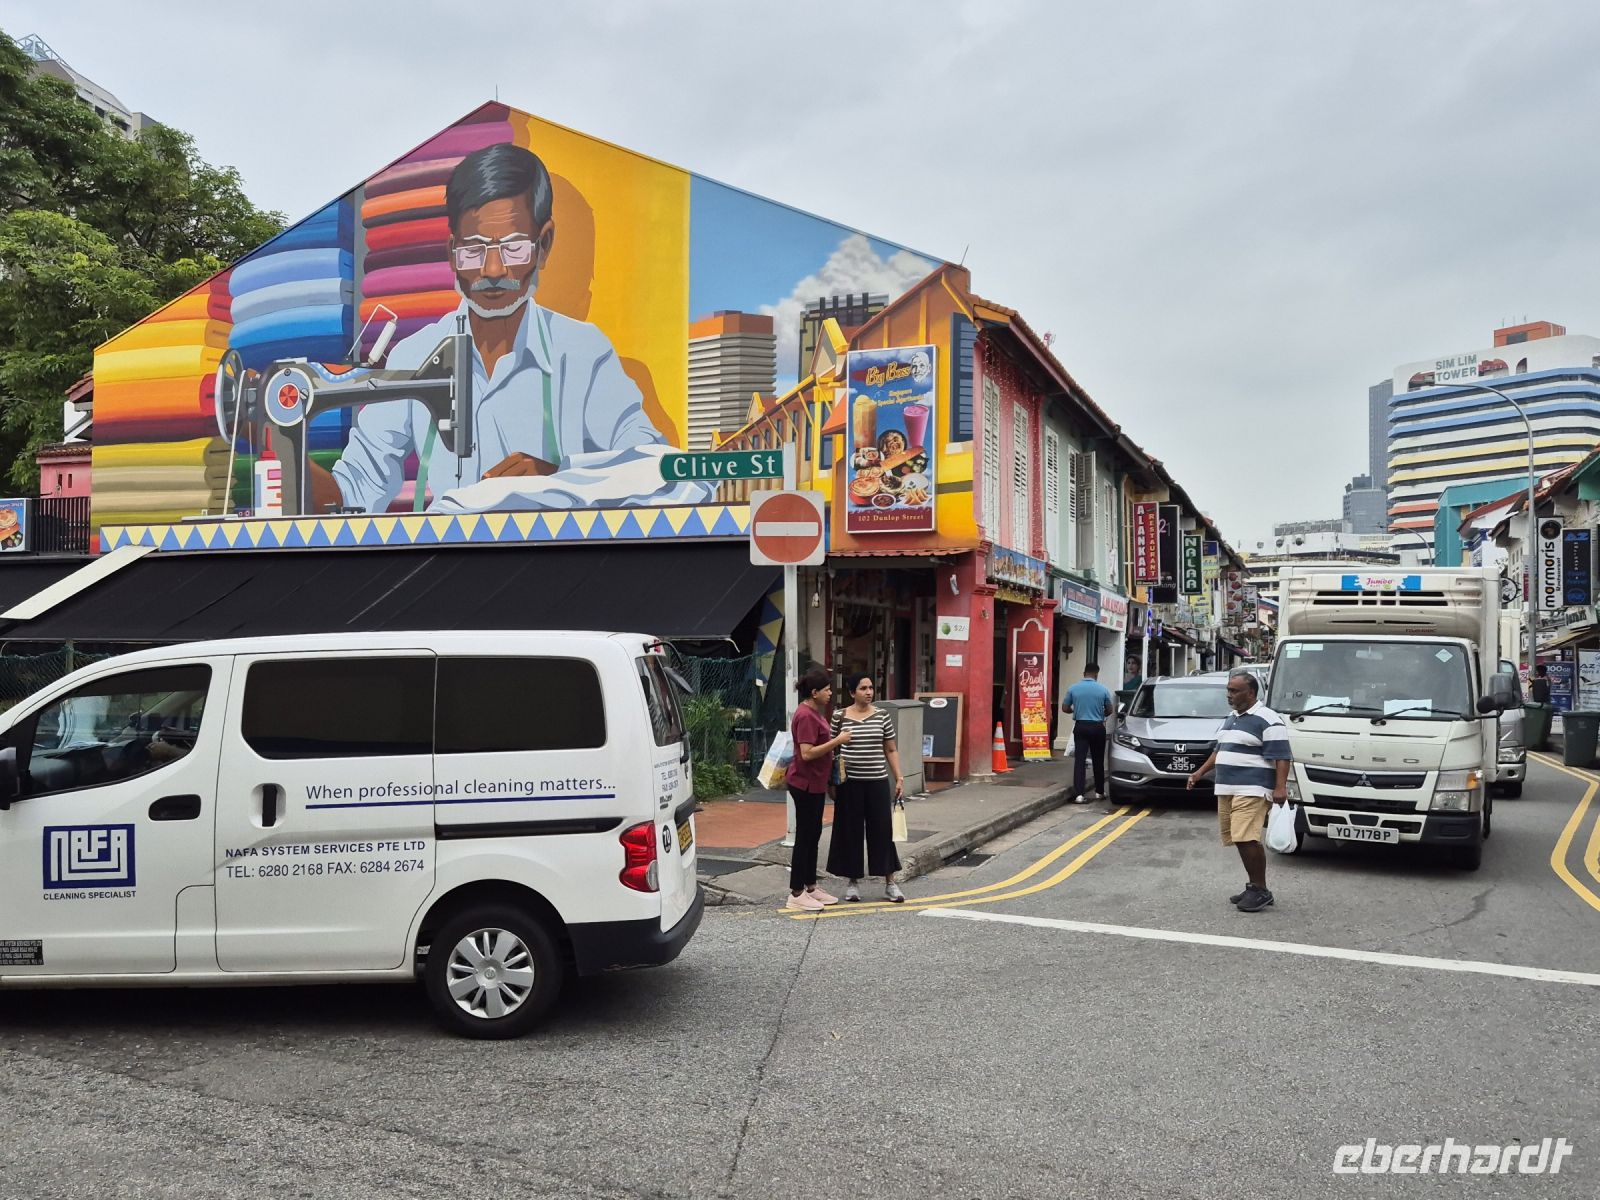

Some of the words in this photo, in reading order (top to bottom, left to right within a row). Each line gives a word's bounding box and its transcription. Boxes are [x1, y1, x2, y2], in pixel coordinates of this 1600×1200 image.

[1436, 359, 1454, 370] SIM
[1458, 354, 1476, 366] LIM
[866, 366, 885, 388] Big
[886, 361, 911, 382] Boss
[1436, 366, 1476, 381] TOWER
[673, 456, 738, 478] Clive
[751, 455, 776, 475] St
[873, 514, 900, 522] Dunlop
[902, 513, 924, 521] Street
[1137, 505, 1147, 577] ALANKAR
[1148, 513, 1156, 577] RESTAURANT
[1184, 537, 1197, 589] NALAA
[1172, 756, 1190, 764] SMC
[1312, 753, 1420, 764] FUSO
[306, 785, 353, 799] When
[359, 780, 458, 801] professional
[464, 778, 534, 796] cleaning
[540, 777, 616, 792] matters...
[1353, 829, 1381, 840] 7178
[1384, 831, 1391, 840] P
[225, 848, 258, 858] NAFA
[262, 845, 310, 856] SYSTEM
[314, 843, 374, 854] SERVICES
[377, 842, 400, 852] PTE
[404, 841, 426, 851] LTD
[226, 866, 255, 878] TEL:
[258, 864, 289, 877] 6280
[292, 863, 323, 876] 2168
[327, 862, 356, 875] FAX:
[360, 860, 391, 873] 6284
[394, 859, 425, 872] 2674
[43, 892, 86, 901] CLEANING
[88, 890, 137, 900] SPECIALIST
